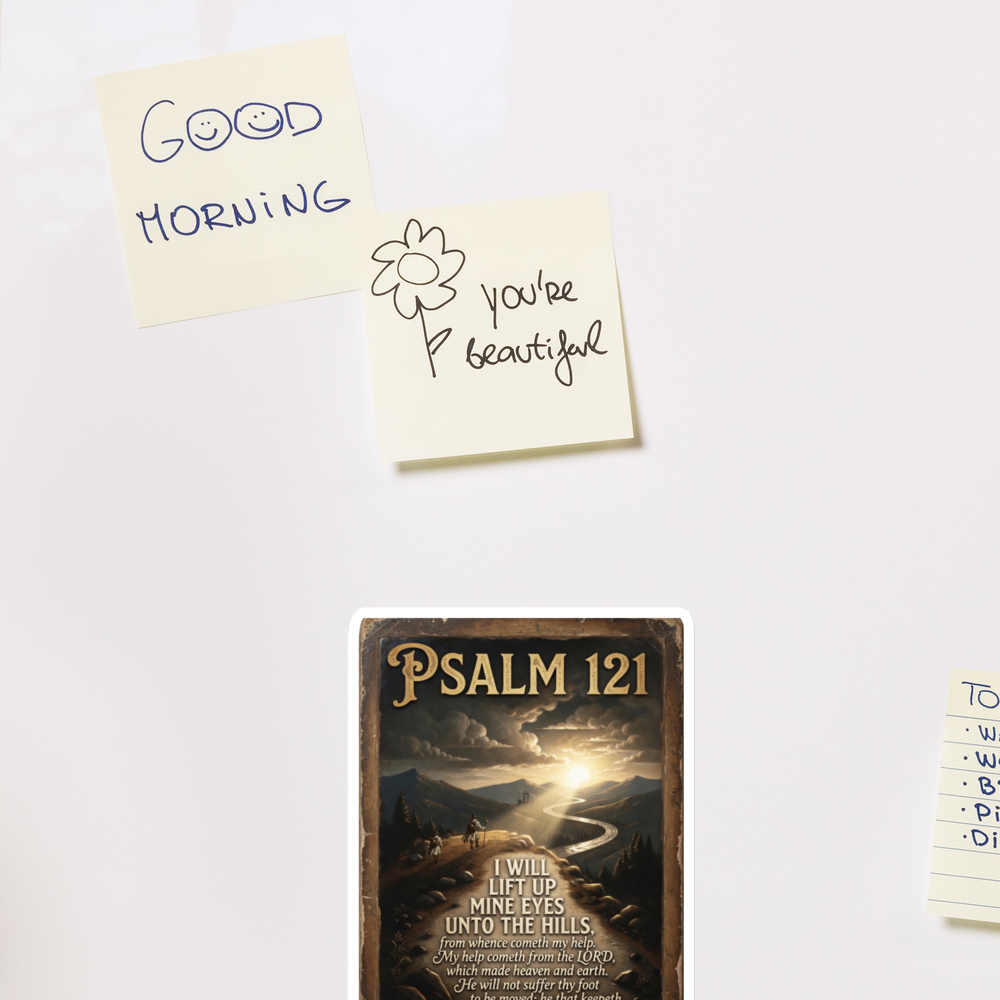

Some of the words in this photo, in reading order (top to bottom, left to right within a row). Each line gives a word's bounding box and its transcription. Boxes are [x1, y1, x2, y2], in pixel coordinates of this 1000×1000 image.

[140, 99, 323, 164] GOOD
[465, 319, 609, 387] beautiful
[387, 642, 567, 708] PSALM
[585, 652, 648, 695] 121
[961, 681, 1000, 709] TO
[494, 858, 500, 876] I
[506, 858, 551, 876] WILL
[489, 878, 526, 896] LIFT
[532, 878, 557, 896] UP
[470, 898, 515, 915] MINE
[521, 898, 565, 915] EYES
[445, 916, 494, 935] UNTO
[500, 916, 535, 935] THE
[542, 916, 595, 937] HILLS,
[439, 936, 466, 951] from
[468, 936, 508, 949] whence
[510, 936, 550, 949] cometh
[552, 939, 569, 951] my
[570, 936, 597, 951] help.
[432, 950, 460, 965] My
[461, 950, 485, 965] help
[487, 950, 526, 962] cometh
[526, 950, 554, 965] from
[557, 950, 575, 962] the
[577, 950, 616, 966] LORD,
[446, 964, 479, 976] which
[481, 964, 511, 976] made
[513, 964, 552, 976] heaven
[553, 964, 575, 976] and
[577, 964, 609, 976] earth.
[453, 978, 477, 993] He
[480, 978, 500, 990] will
[502, 979, 521, 990] not
[523, 978, 556, 994] suffer
[558, 978, 576, 994] thy
[575, 978, 600, 994] foot
